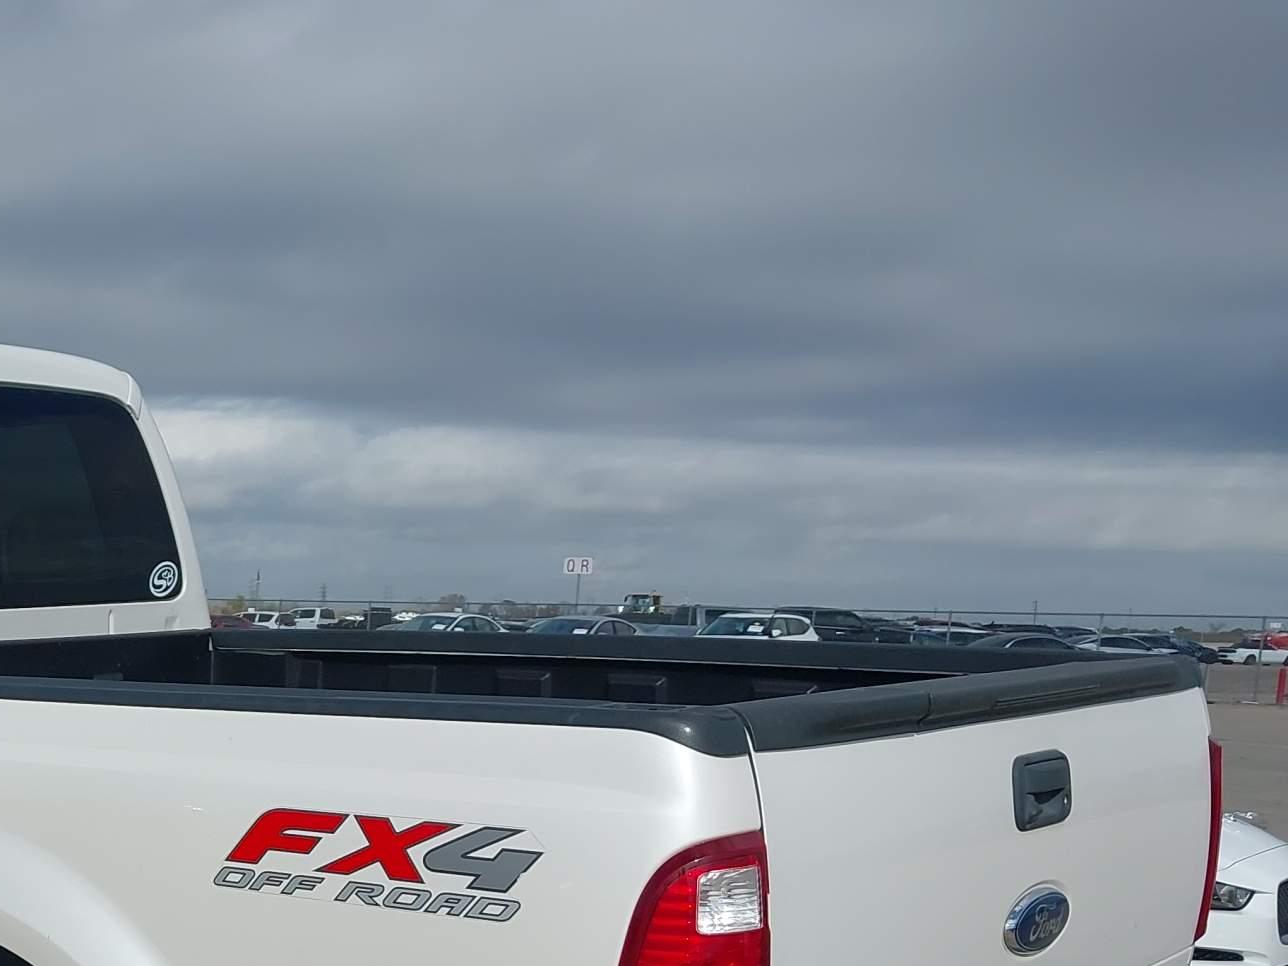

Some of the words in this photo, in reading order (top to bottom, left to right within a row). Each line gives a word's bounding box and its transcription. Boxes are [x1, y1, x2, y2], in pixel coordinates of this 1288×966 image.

[581, 559, 589, 573] R
[224, 807, 545, 893] FX4
[212, 865, 326, 896] OFF
[332, 880, 521, 922] ROAD
